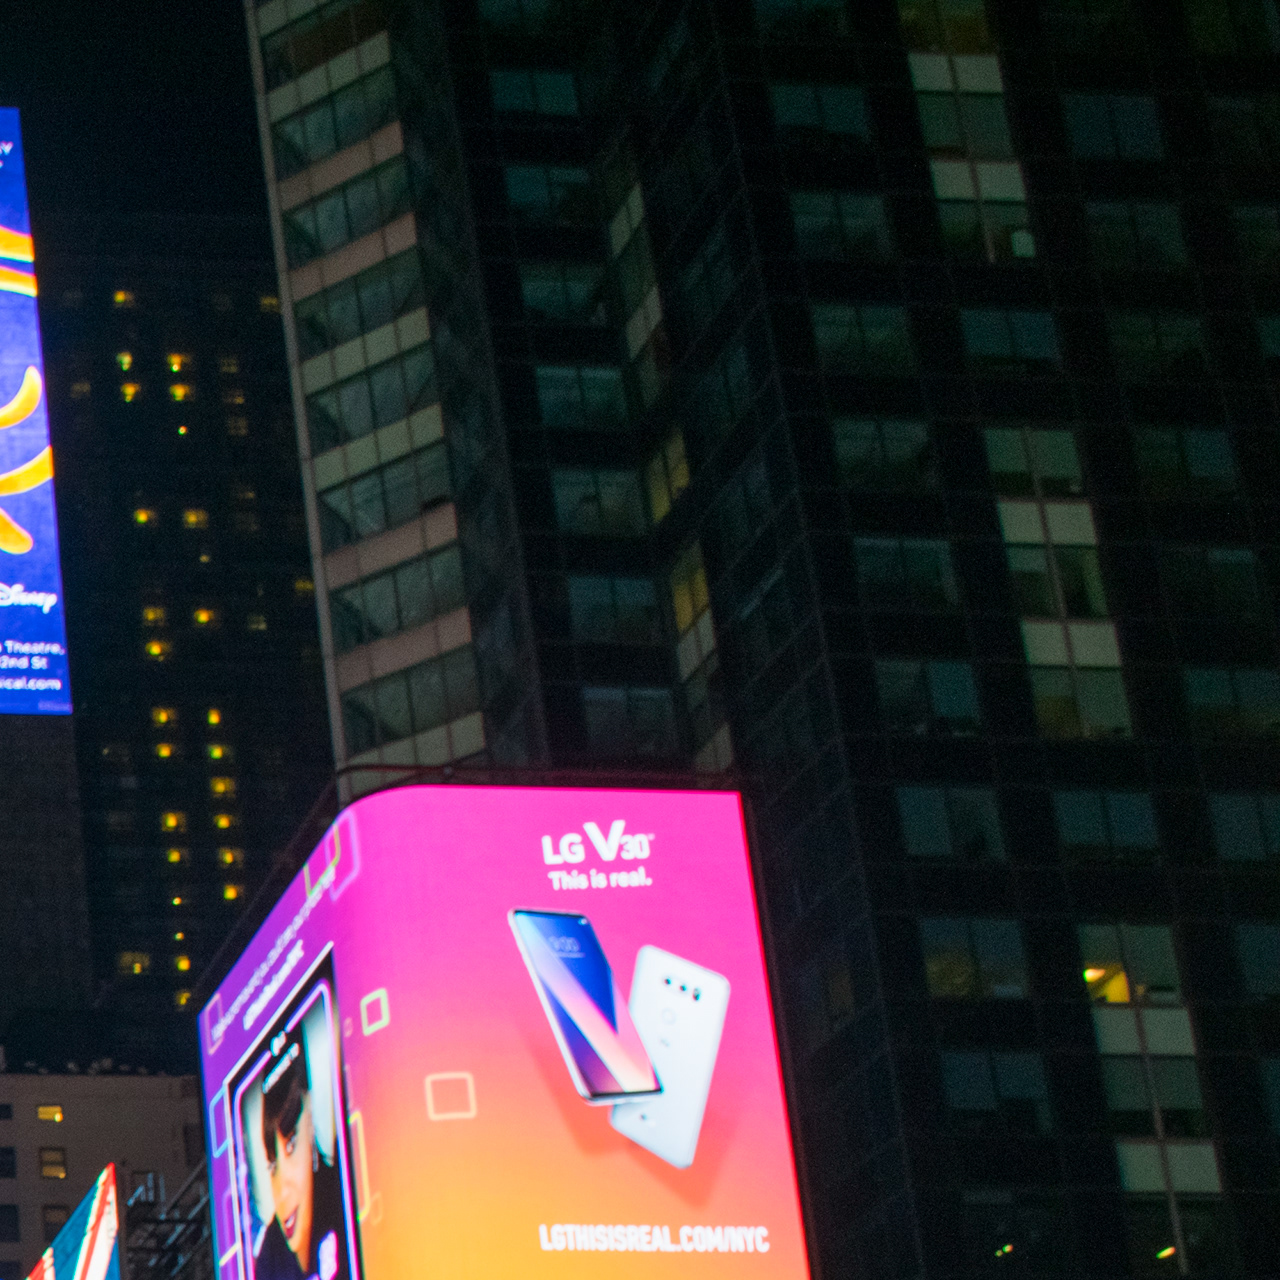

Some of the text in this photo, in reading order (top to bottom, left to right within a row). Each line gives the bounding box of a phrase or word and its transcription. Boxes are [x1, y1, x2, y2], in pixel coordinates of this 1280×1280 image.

[4, 640, 65, 655] Theatre,
[31, 656, 48, 669] St
[542, 819, 651, 865] LG V30
[548, 865, 653, 890] This is real.
[538, 1223, 771, 1253] LGTHISISREAL.COM/NYC
